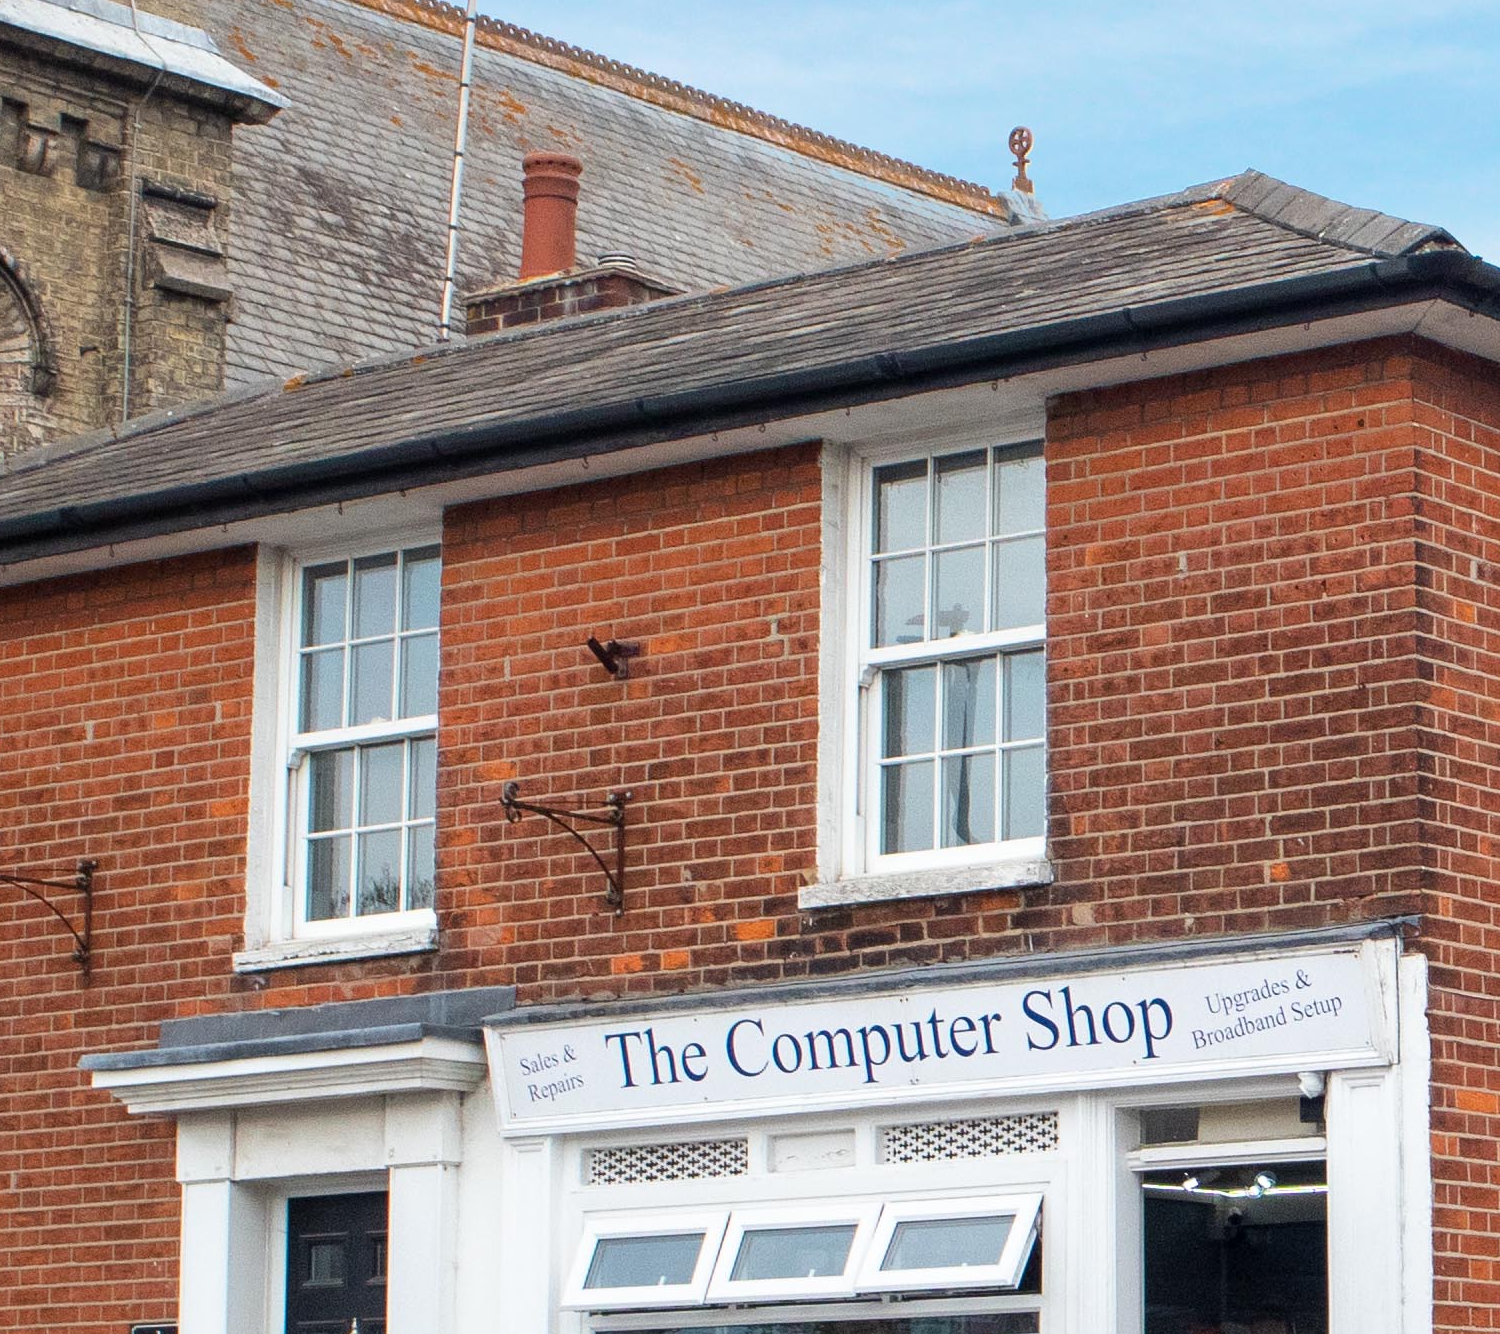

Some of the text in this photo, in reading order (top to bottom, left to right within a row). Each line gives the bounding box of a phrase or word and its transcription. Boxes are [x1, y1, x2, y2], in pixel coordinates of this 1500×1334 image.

[1205, 968, 1312, 1016] Upgrades &
[604, 986, 1174, 1089] The Computer Shop
[1192, 995, 1344, 1051] Broadband Setup
[519, 1044, 578, 1077] Sales &
[527, 1072, 585, 1103] Repairs
